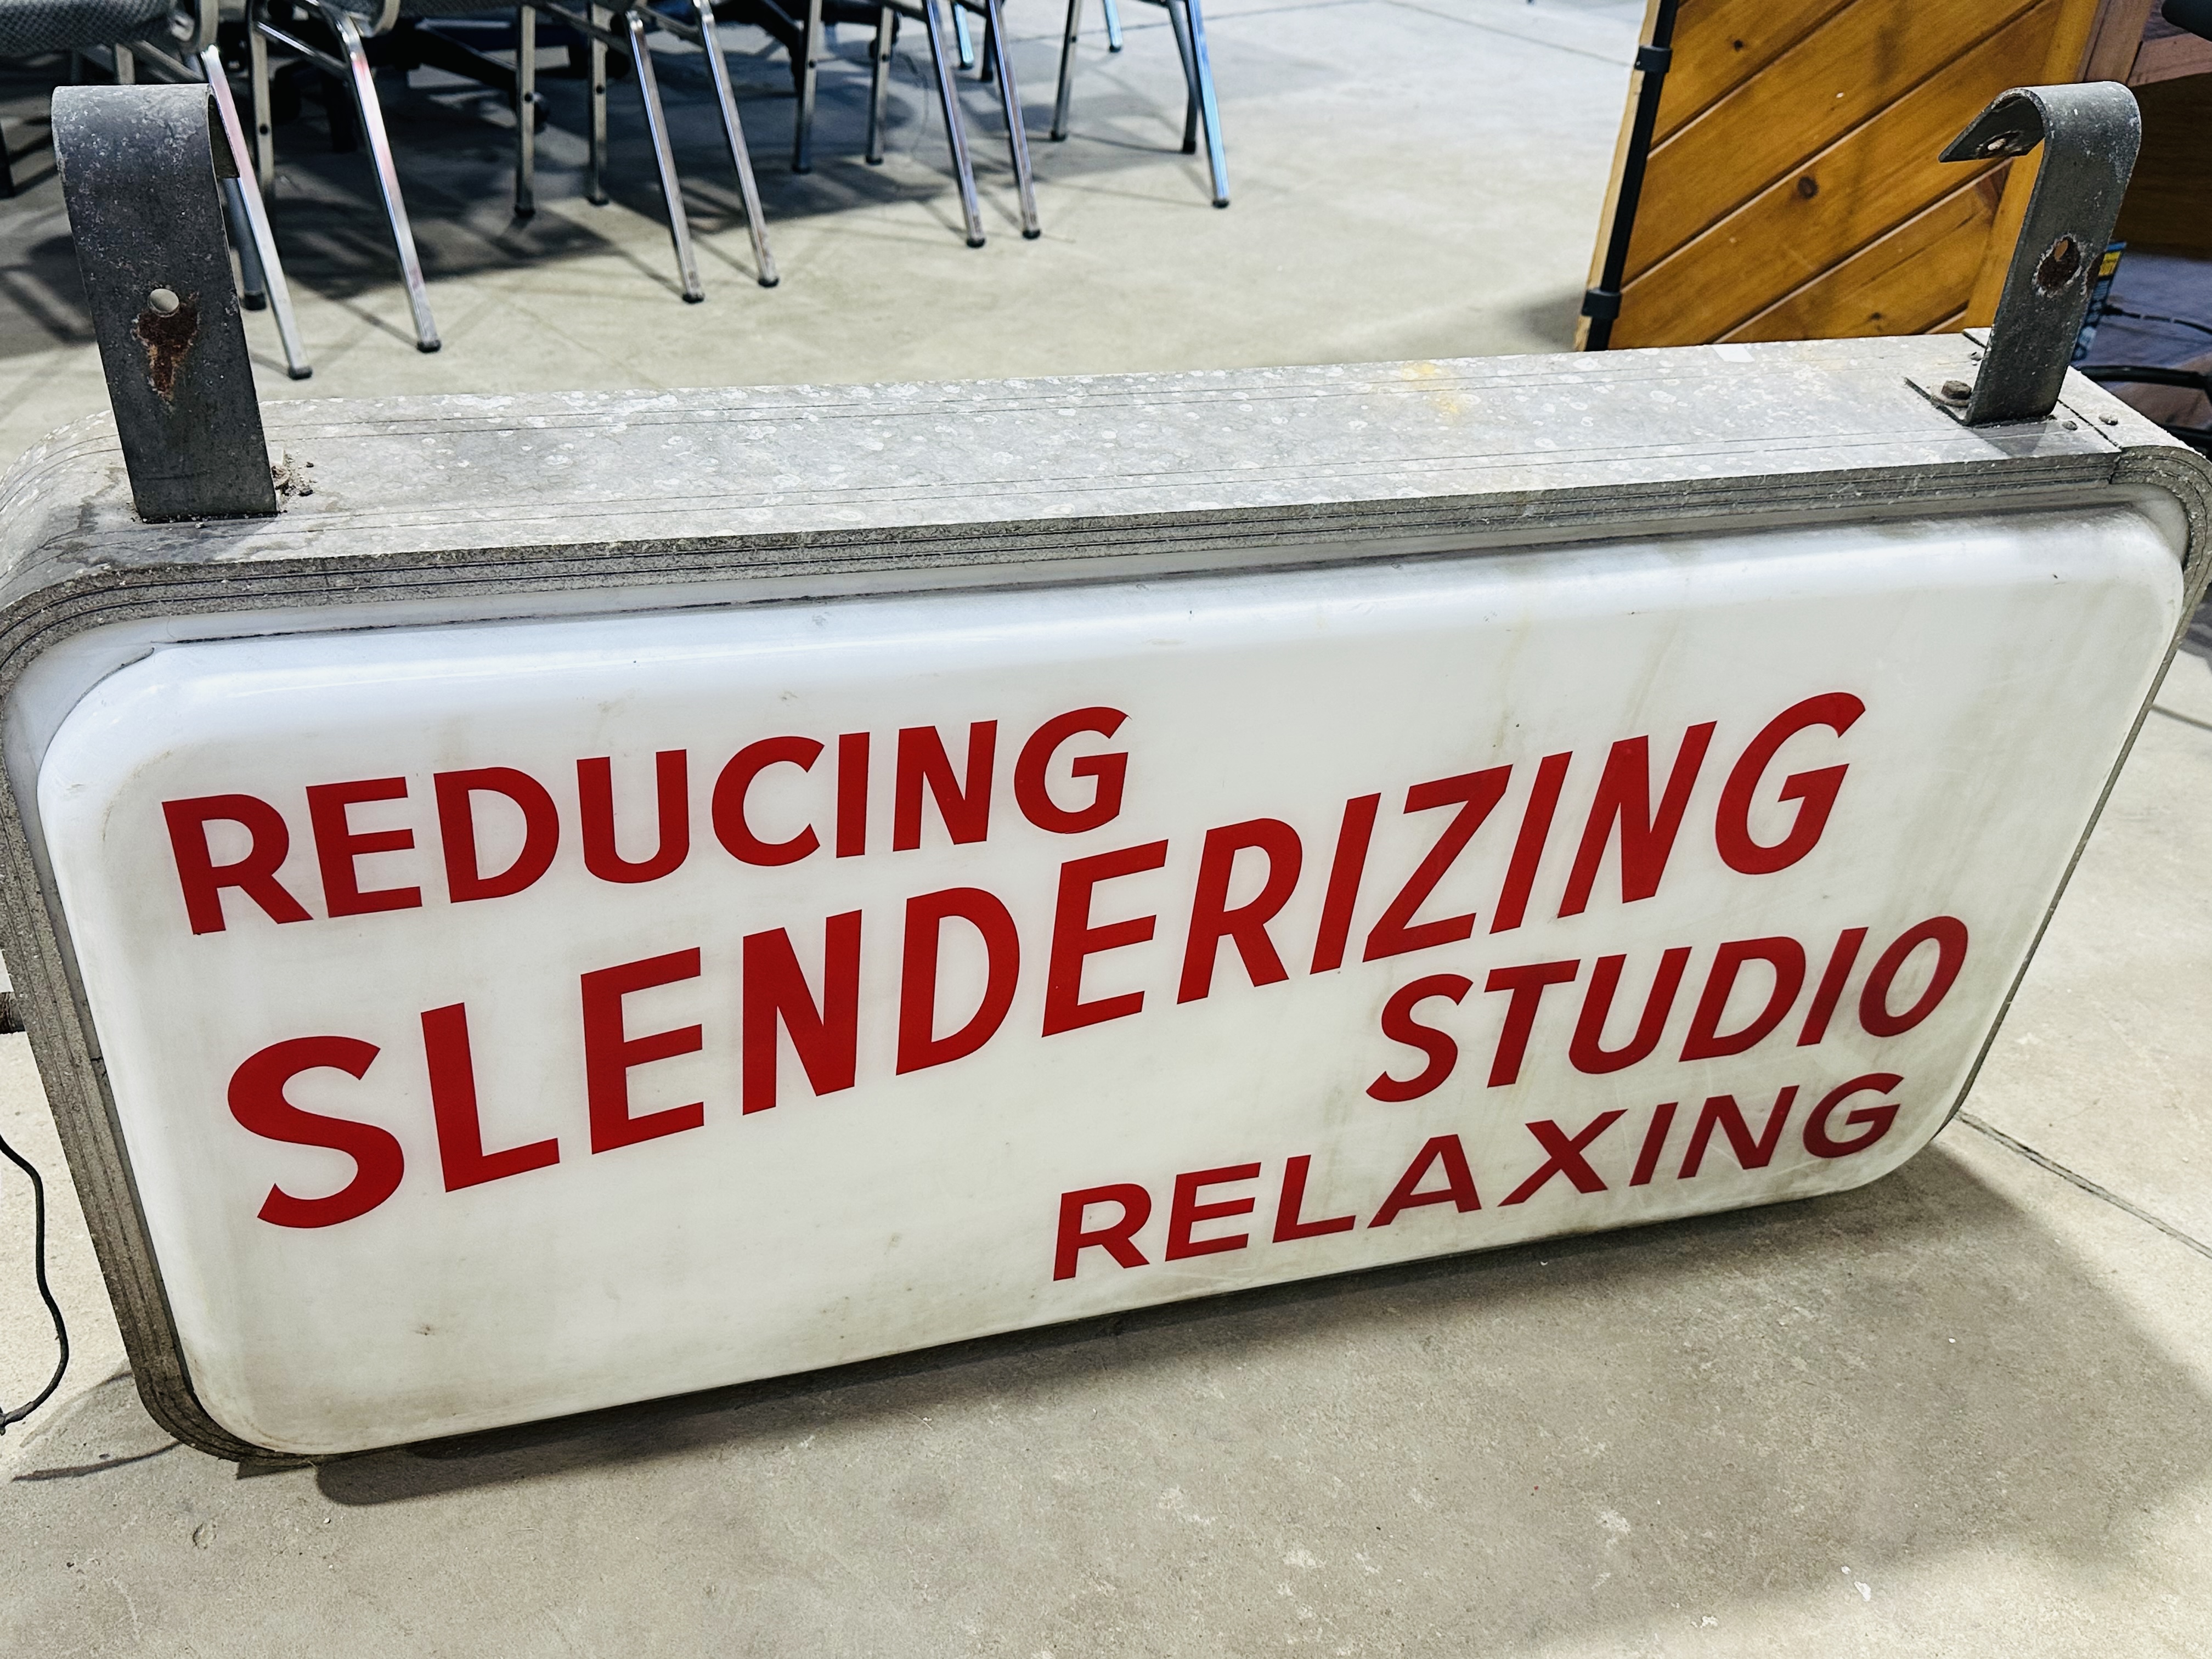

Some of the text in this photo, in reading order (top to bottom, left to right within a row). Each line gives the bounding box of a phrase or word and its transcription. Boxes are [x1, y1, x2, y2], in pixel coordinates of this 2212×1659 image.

[161, 706, 1129, 935] REDUCING
[227, 691, 1866, 1229] SLENDERIZING
[1365, 916, 1969, 1103] STUDIO
[1053, 1072, 1903, 1281] RELAXING
